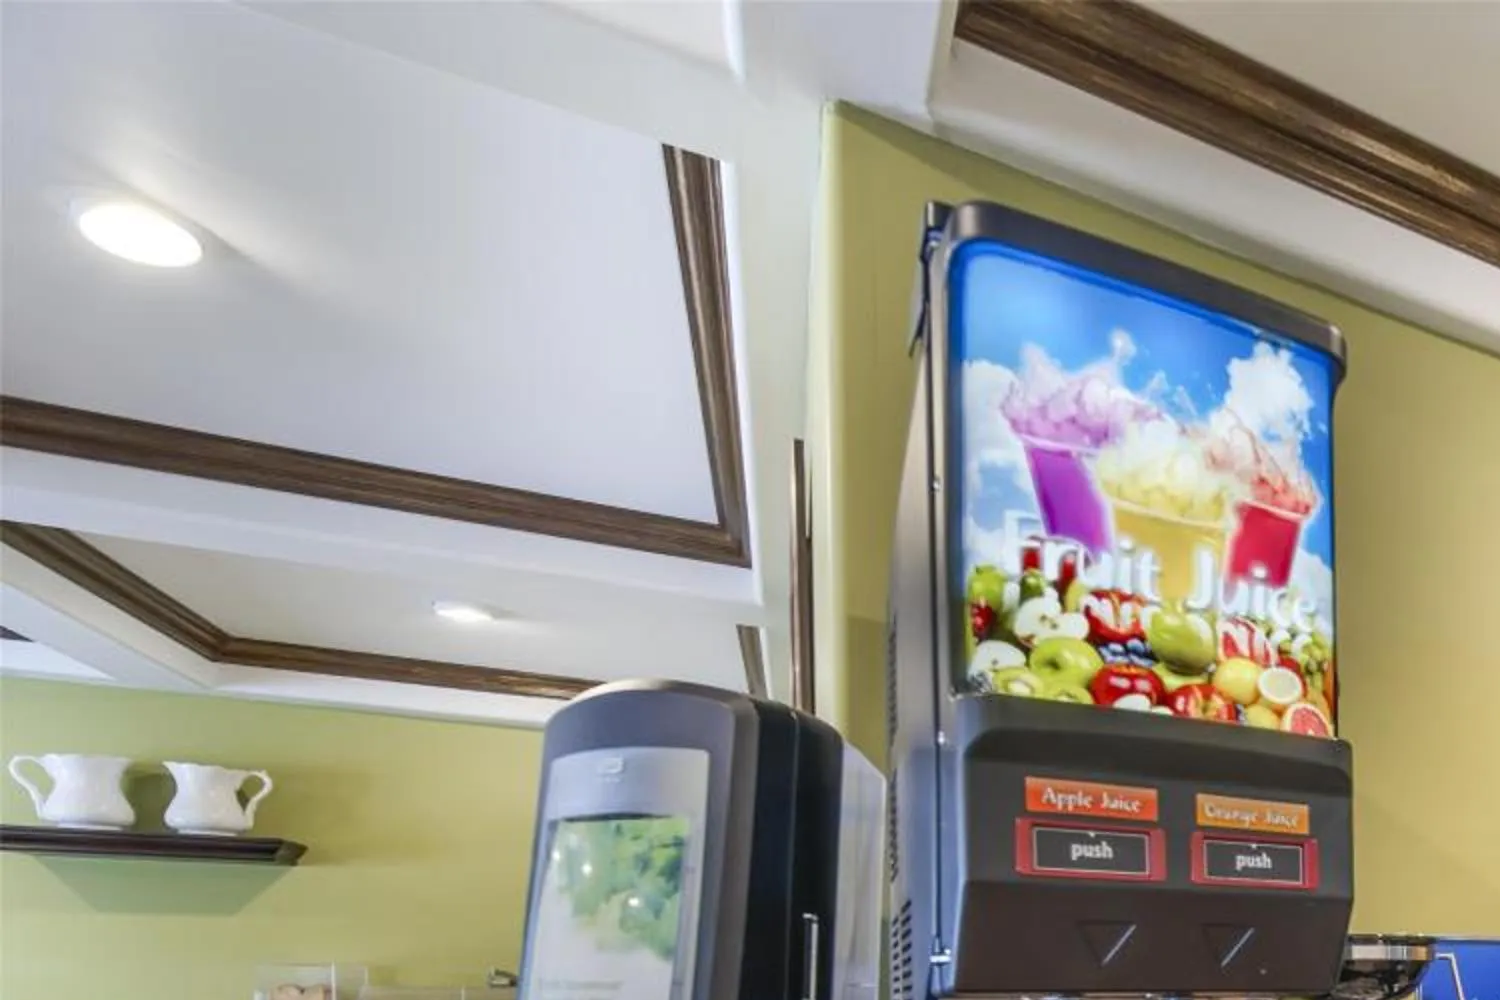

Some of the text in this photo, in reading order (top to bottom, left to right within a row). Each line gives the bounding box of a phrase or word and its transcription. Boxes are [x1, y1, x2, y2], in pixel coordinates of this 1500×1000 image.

[1004, 510, 1317, 633] Fruit Juice
[1041, 786, 1141, 813] Apple Juice
[1204, 802, 1257, 827] Orange
[1071, 841, 1113, 860] push
[1235, 851, 1273, 871] push
